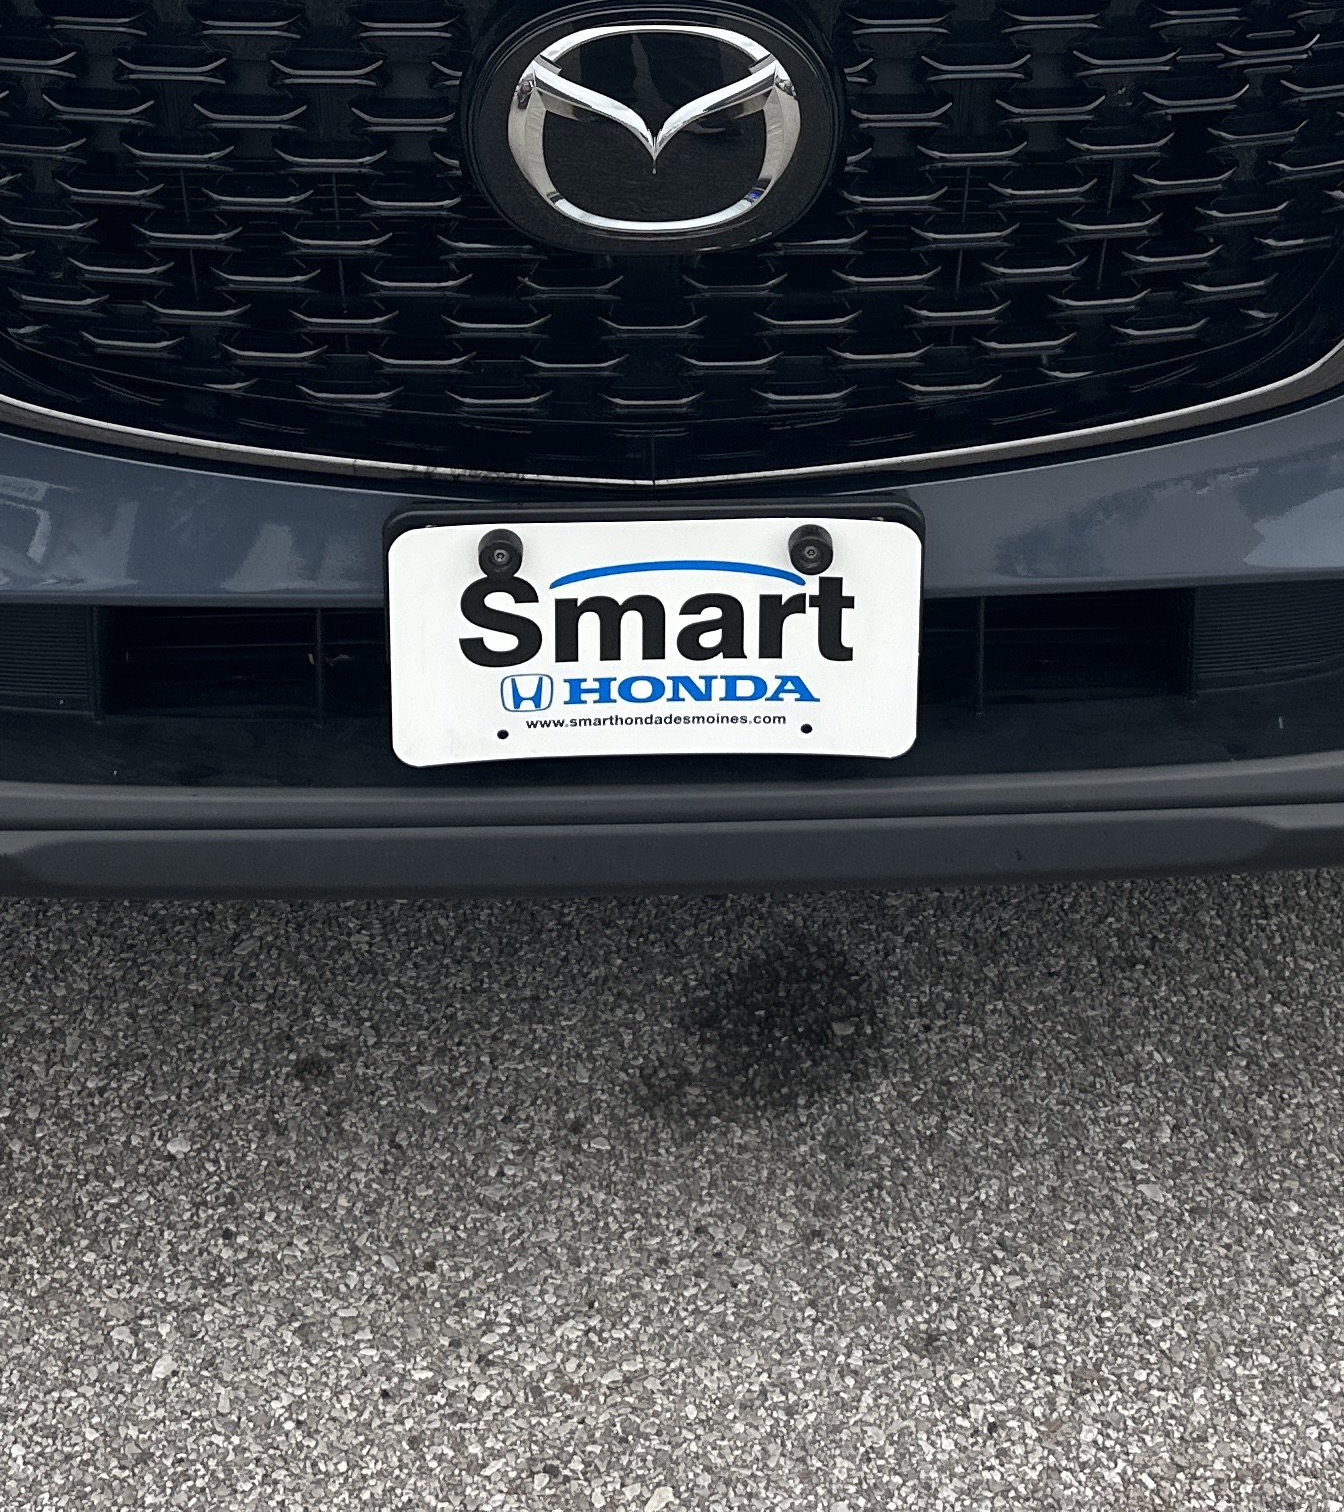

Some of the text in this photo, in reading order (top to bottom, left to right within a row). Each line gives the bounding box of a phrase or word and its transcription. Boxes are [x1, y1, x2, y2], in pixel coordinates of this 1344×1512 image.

[458, 574, 855, 668] Smart
[562, 674, 821, 706] HONDA
[525, 712, 787, 729] www.smarthondadesmoines.com
